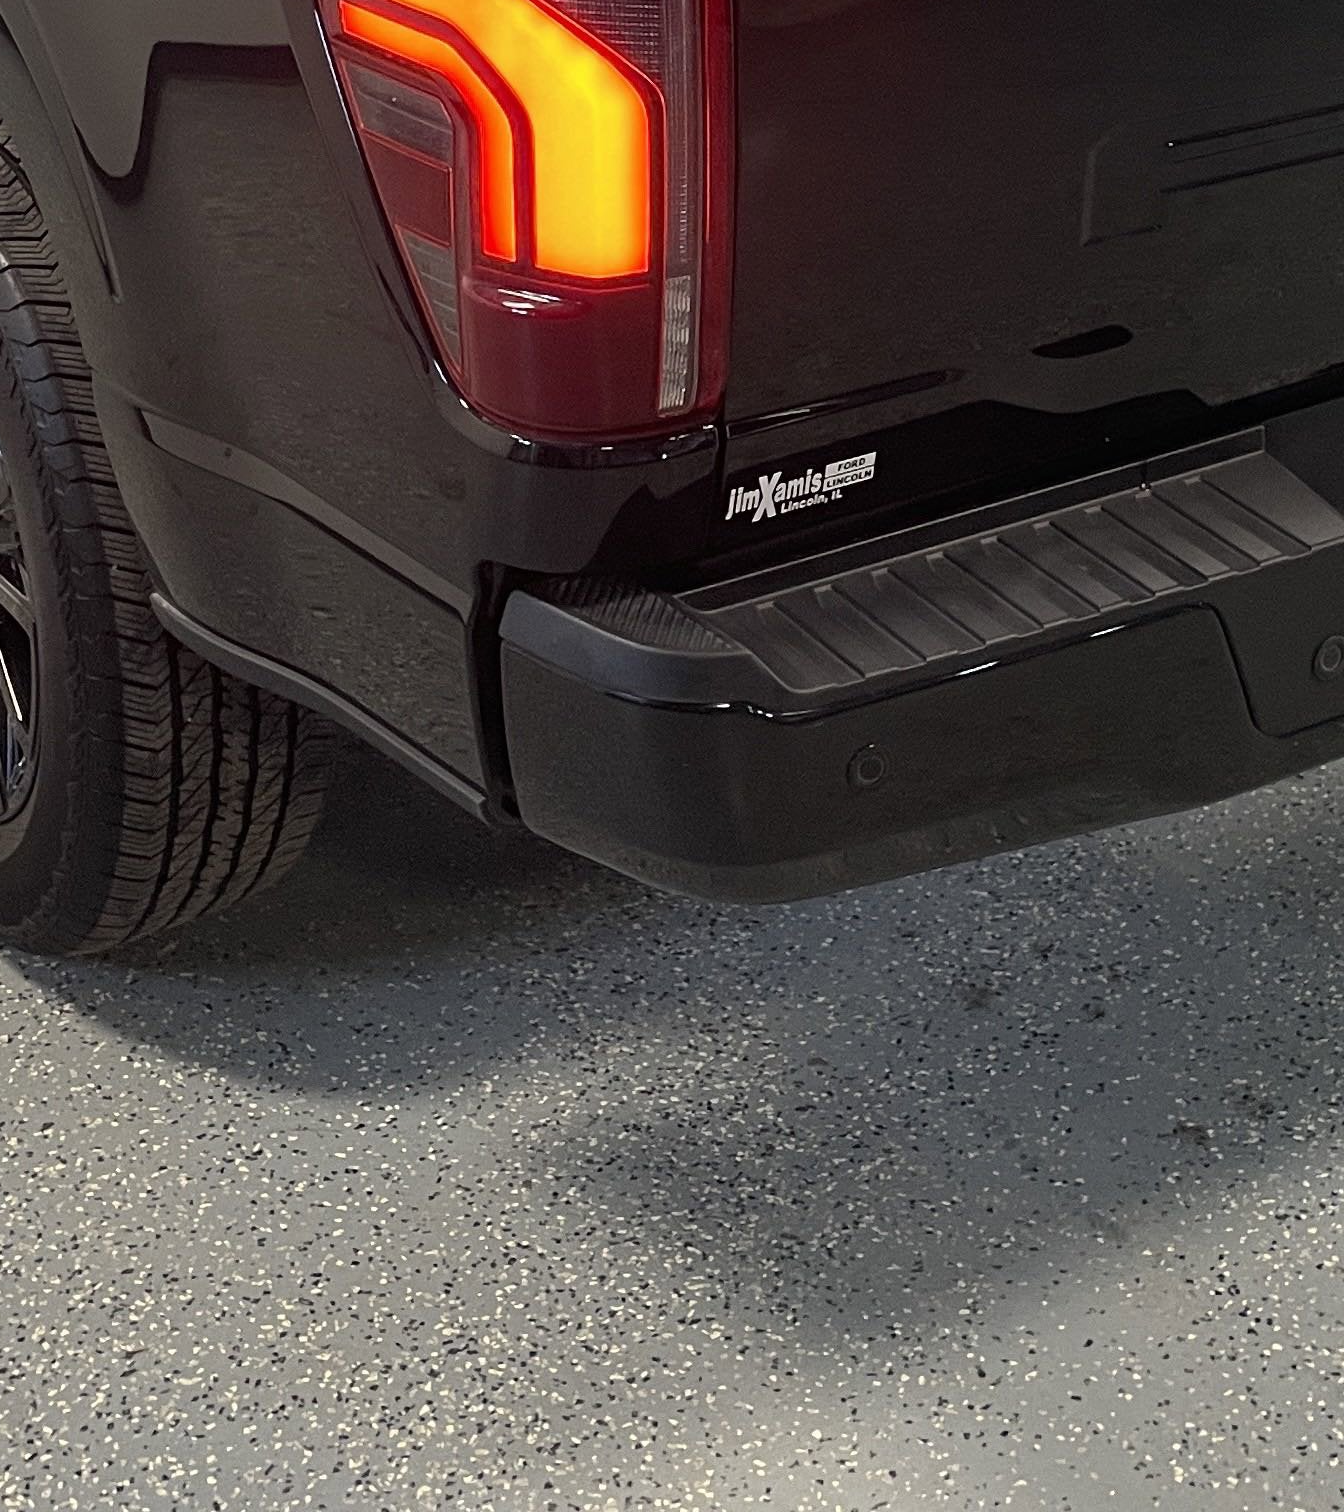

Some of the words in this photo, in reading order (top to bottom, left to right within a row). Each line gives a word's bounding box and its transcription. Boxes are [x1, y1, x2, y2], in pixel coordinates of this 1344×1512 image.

[837, 457, 867, 472] FORD
[826, 469, 873, 488] LINCOLN
[780, 493, 829, 514] Lincoln,
[831, 489, 844, 501] IL
